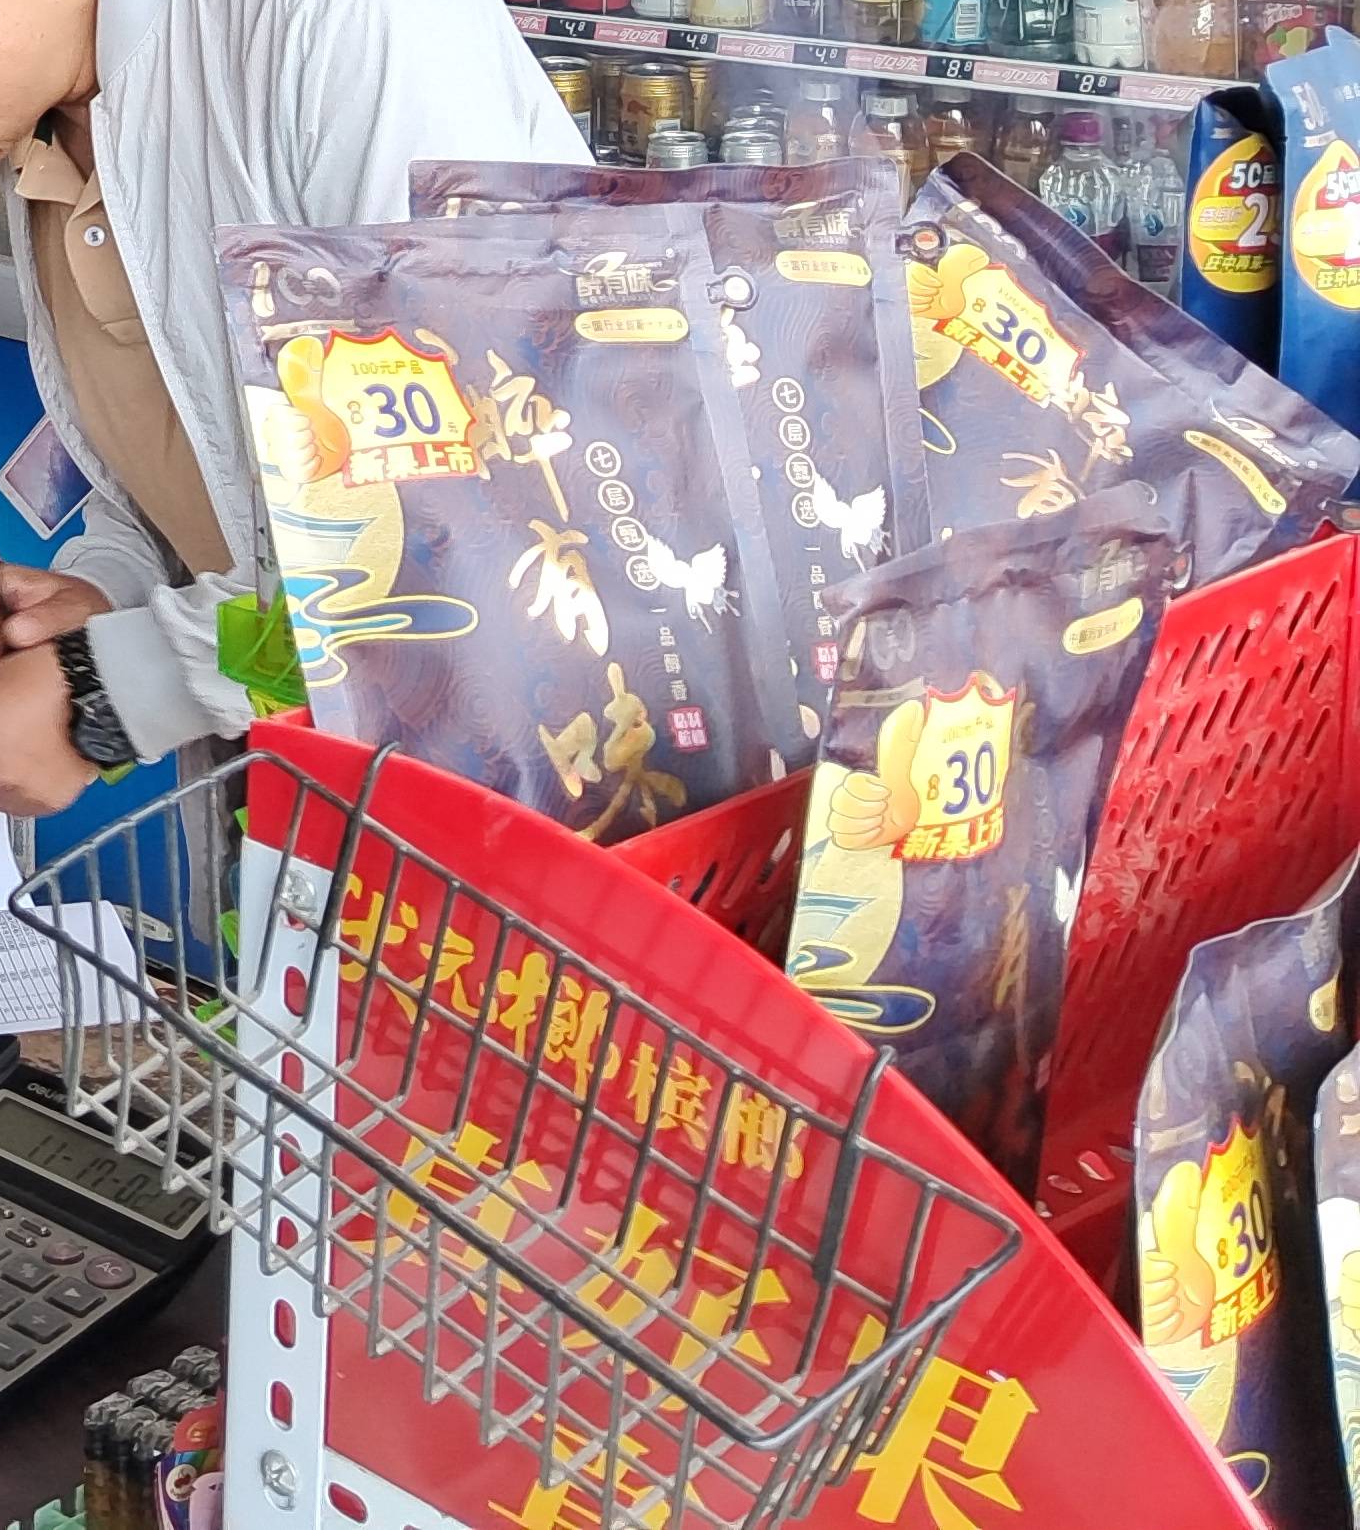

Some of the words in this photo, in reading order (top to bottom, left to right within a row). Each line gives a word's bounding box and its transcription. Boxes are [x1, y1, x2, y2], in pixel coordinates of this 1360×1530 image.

[1237, 191, 1272, 247] 2
[982, 302, 1049, 366] 30
[352, 358, 425, 376] 100元产品
[363, 381, 441, 439] 30
[347, 441, 477, 485] 新果上市
[944, 741, 997, 815] 30
[901, 810, 1004, 860] 新果上市
[1229, 1179, 1270, 1278] 30
[93, 1260, 124, 1279] AC
